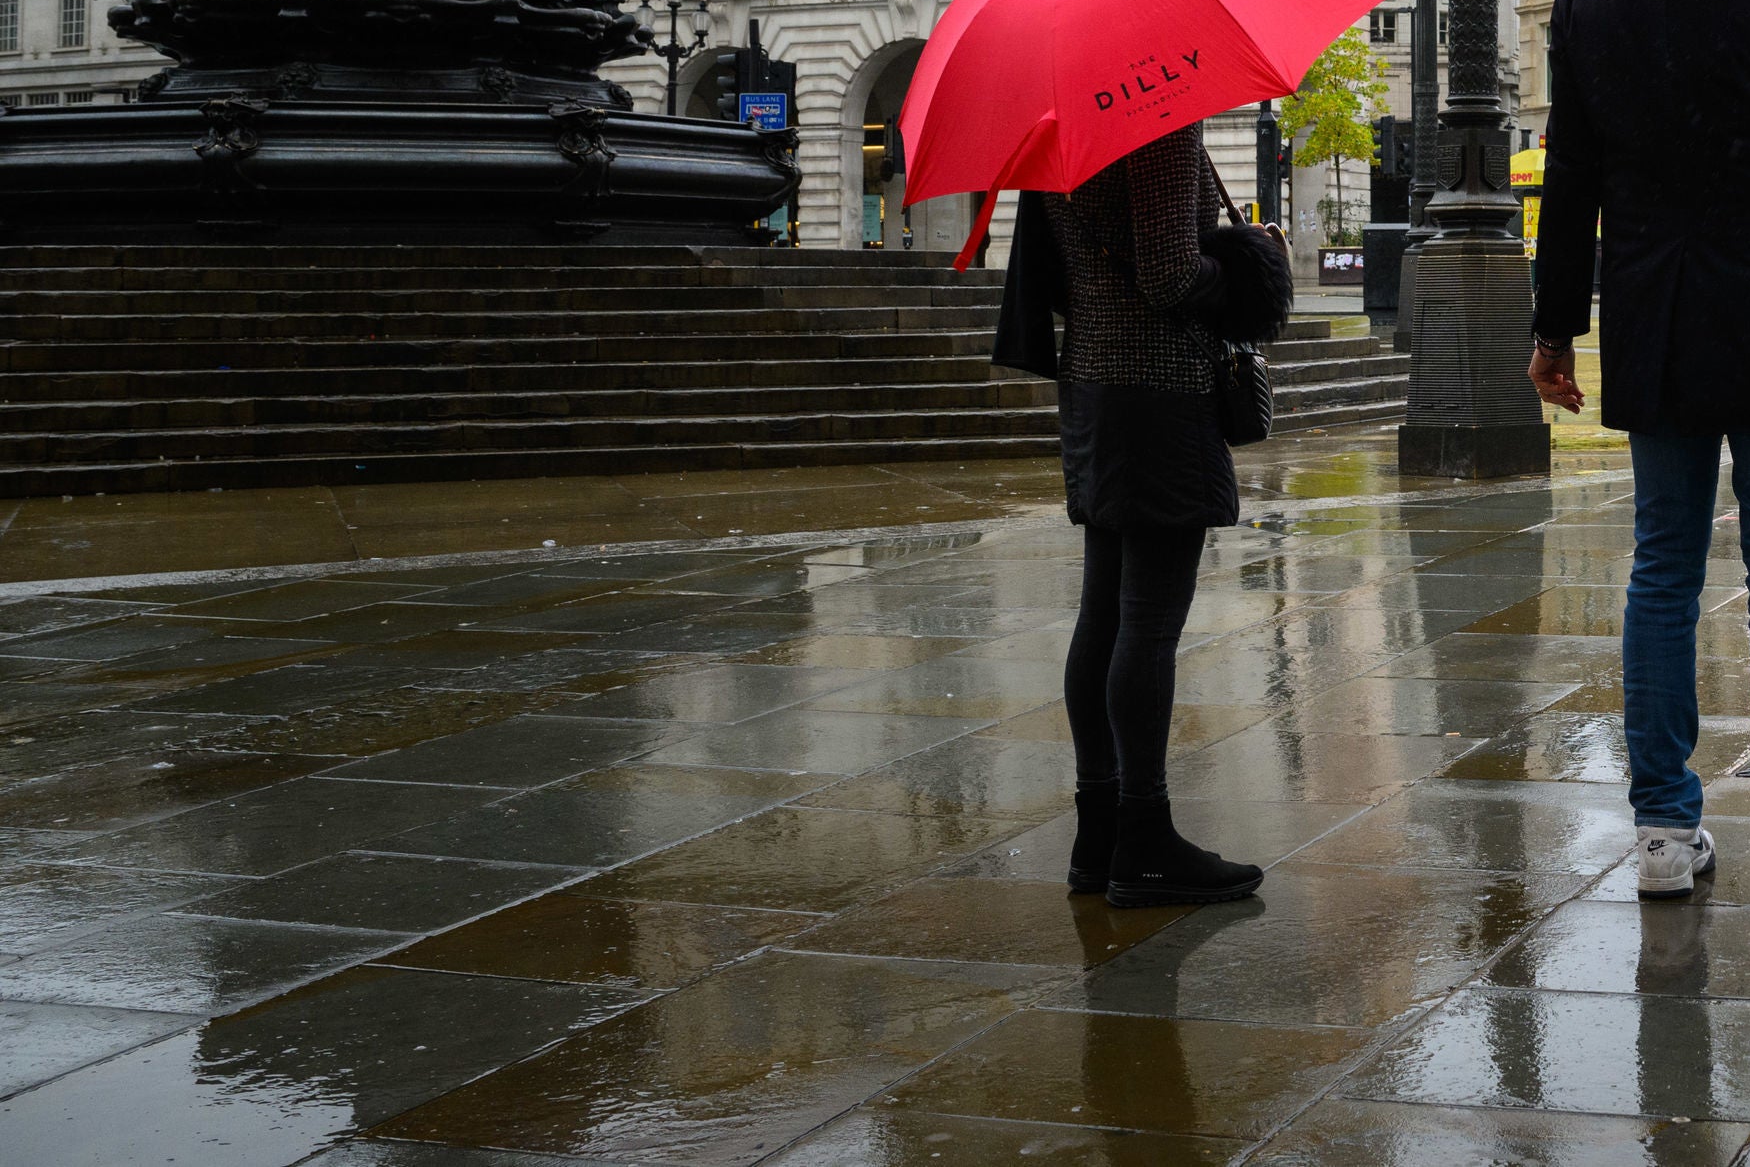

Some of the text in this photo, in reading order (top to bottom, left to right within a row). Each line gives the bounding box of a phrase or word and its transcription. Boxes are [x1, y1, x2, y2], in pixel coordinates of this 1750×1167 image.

[1129, 55, 1156, 71] THE
[1094, 49, 1200, 111] DILLY
[1126, 84, 1192, 118] PICCADILLY
[1510, 173, 1533, 183] SPOT
[1650, 839, 1666, 847] NIKE
